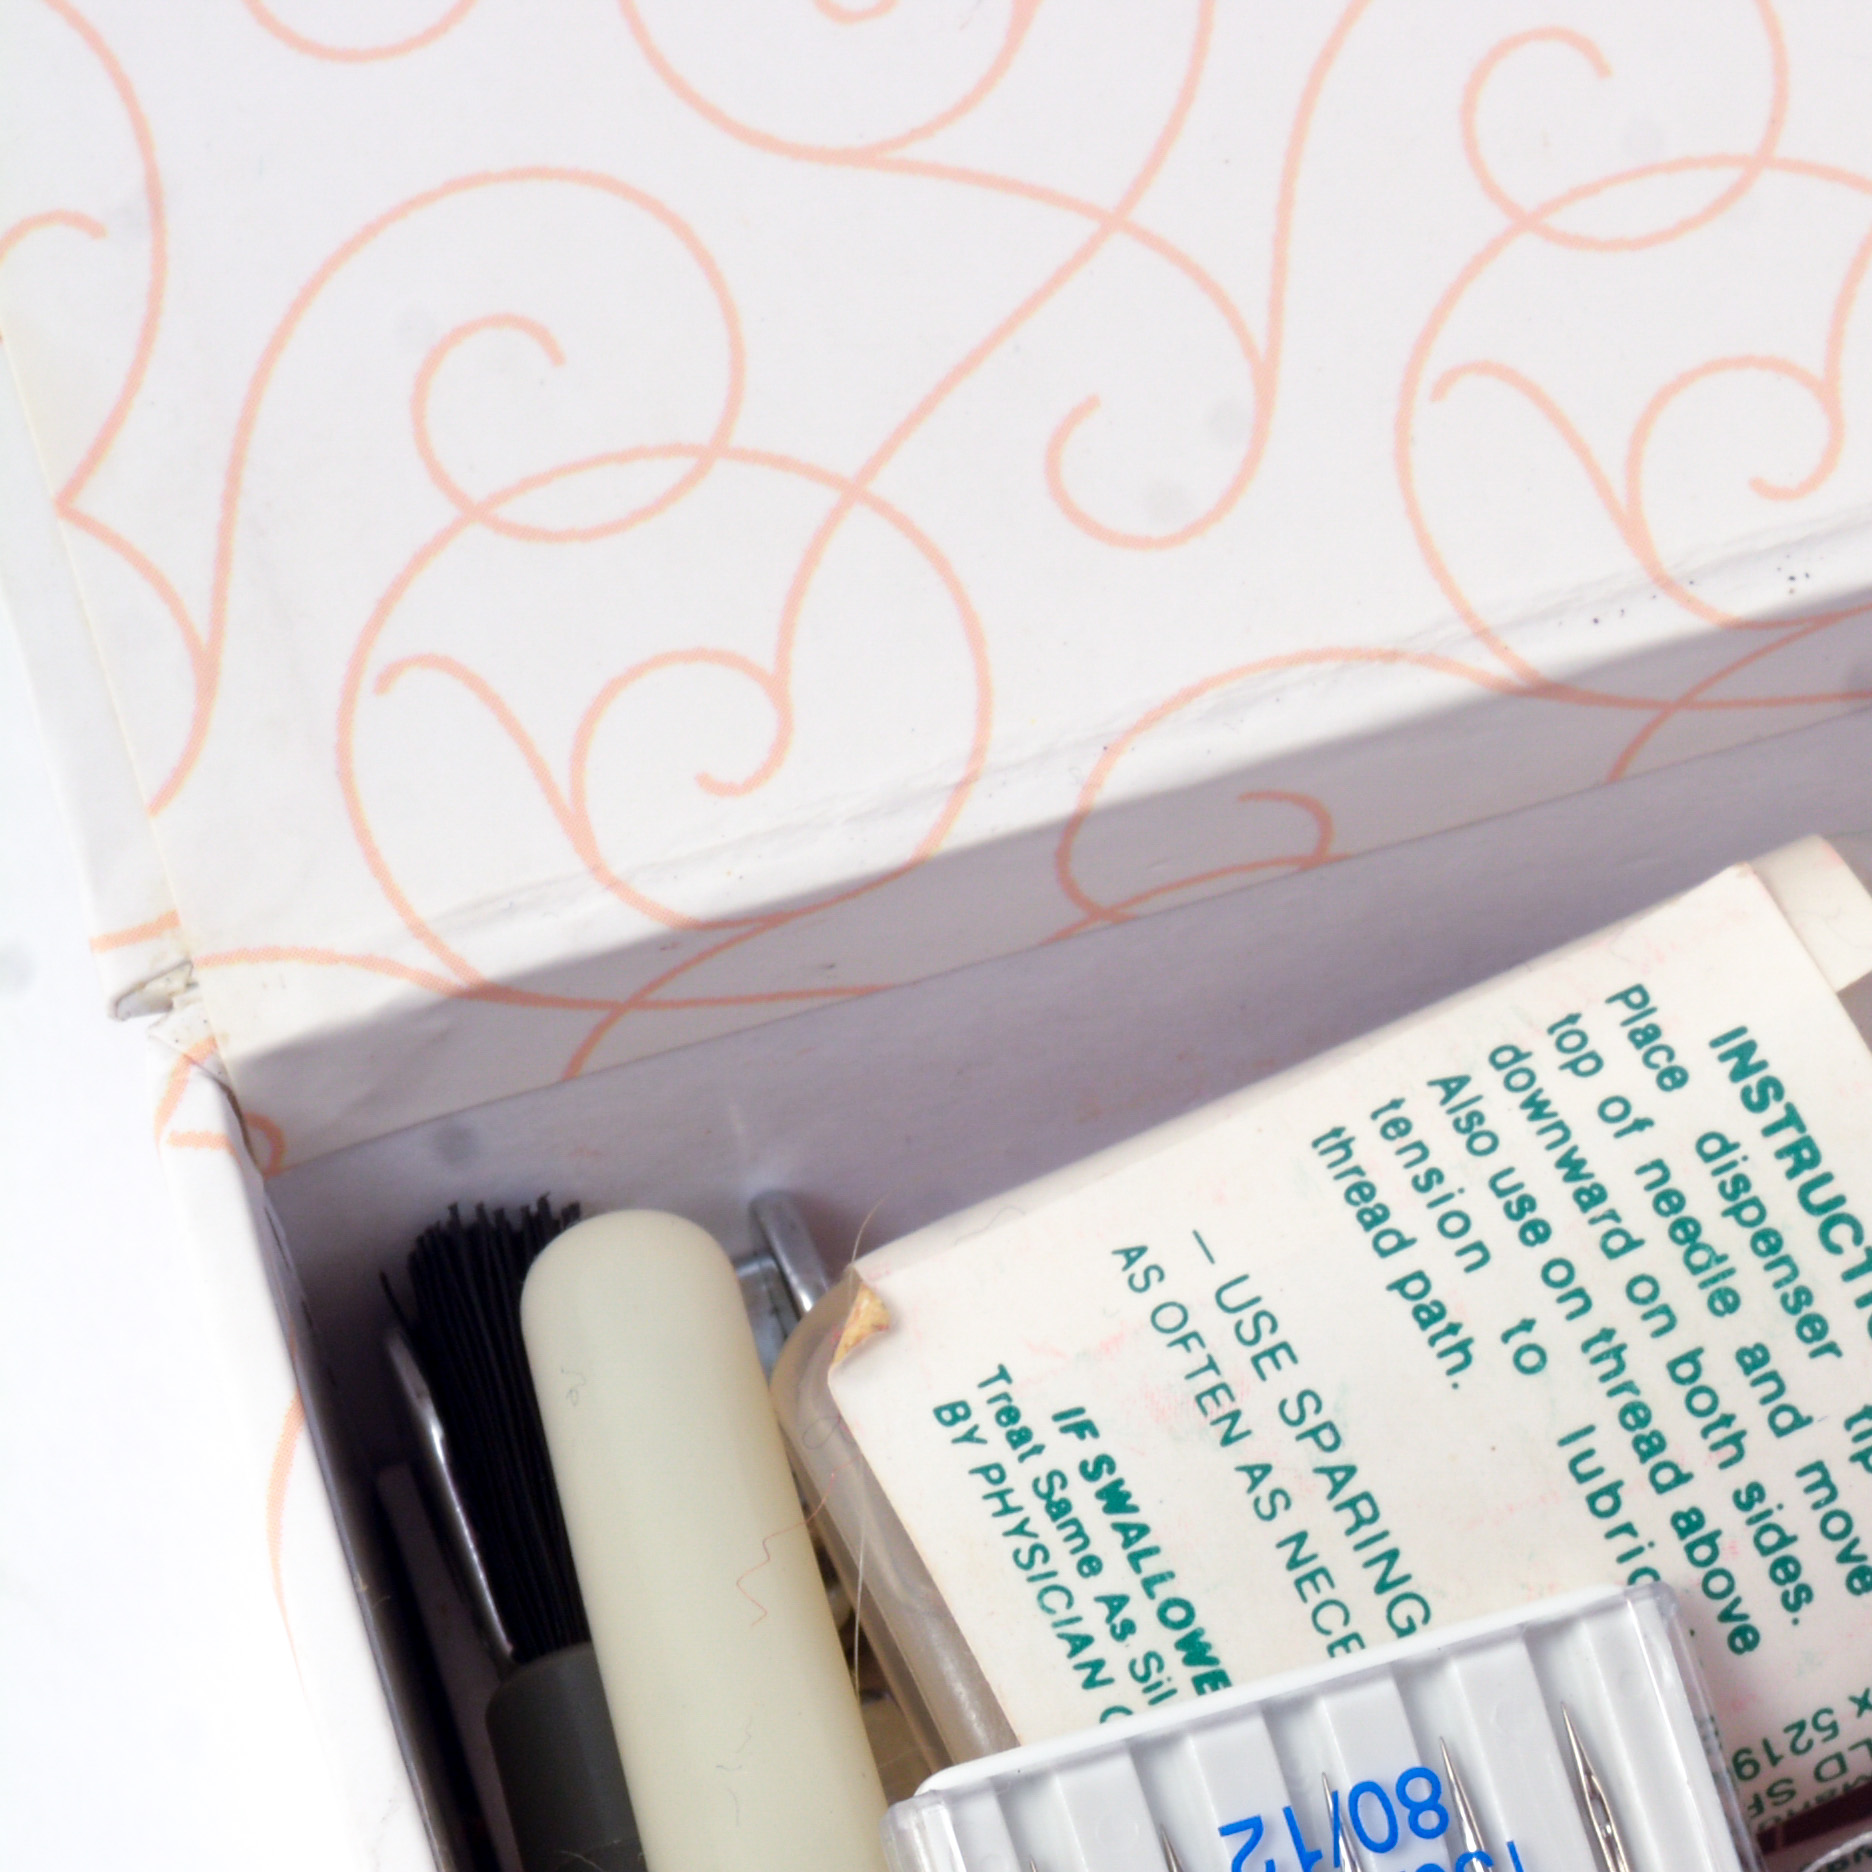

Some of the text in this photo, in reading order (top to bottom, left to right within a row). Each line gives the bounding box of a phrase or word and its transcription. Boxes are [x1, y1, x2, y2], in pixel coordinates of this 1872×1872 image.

[1312, 1127, 1473, 1391] thread path.
[1372, 1099, 1491, 1274] tension
[1502, 1319, 1548, 1376] to
[1548, 1014, 1604, 1078] top
[1598, 1096, 1655, 1139] of
[1636, 1159, 1742, 1318] needle
[1735, 1343, 1813, 1438] and
[1607, 984, 1689, 1092] Place
[1696, 1132, 1843, 1359] dispenser
[1052, 1407, 1099, 1440] IF
[1114, 1246, 1165, 1293] AS
[1151, 1302, 1252, 1448] OFTEN
[1236, 1463, 1292, 1522] AS
[1215, 1275, 1297, 1381] USE
[1428, 1075, 1500, 1157] Also
[1488, 1168, 1552, 1248] use
[1541, 1258, 1593, 1322] on
[1581, 1327, 1694, 1496] thread
[1670, 1506, 1761, 1654] above
[1488, 1045, 1815, 1626] downward on both sides.
[933, 1401, 1115, 1691] BY PHYSICIAN
[979, 1365, 1046, 1462] Treat
[1032, 1469, 1104, 1579] Same
[1094, 1593, 1138, 1643] As
